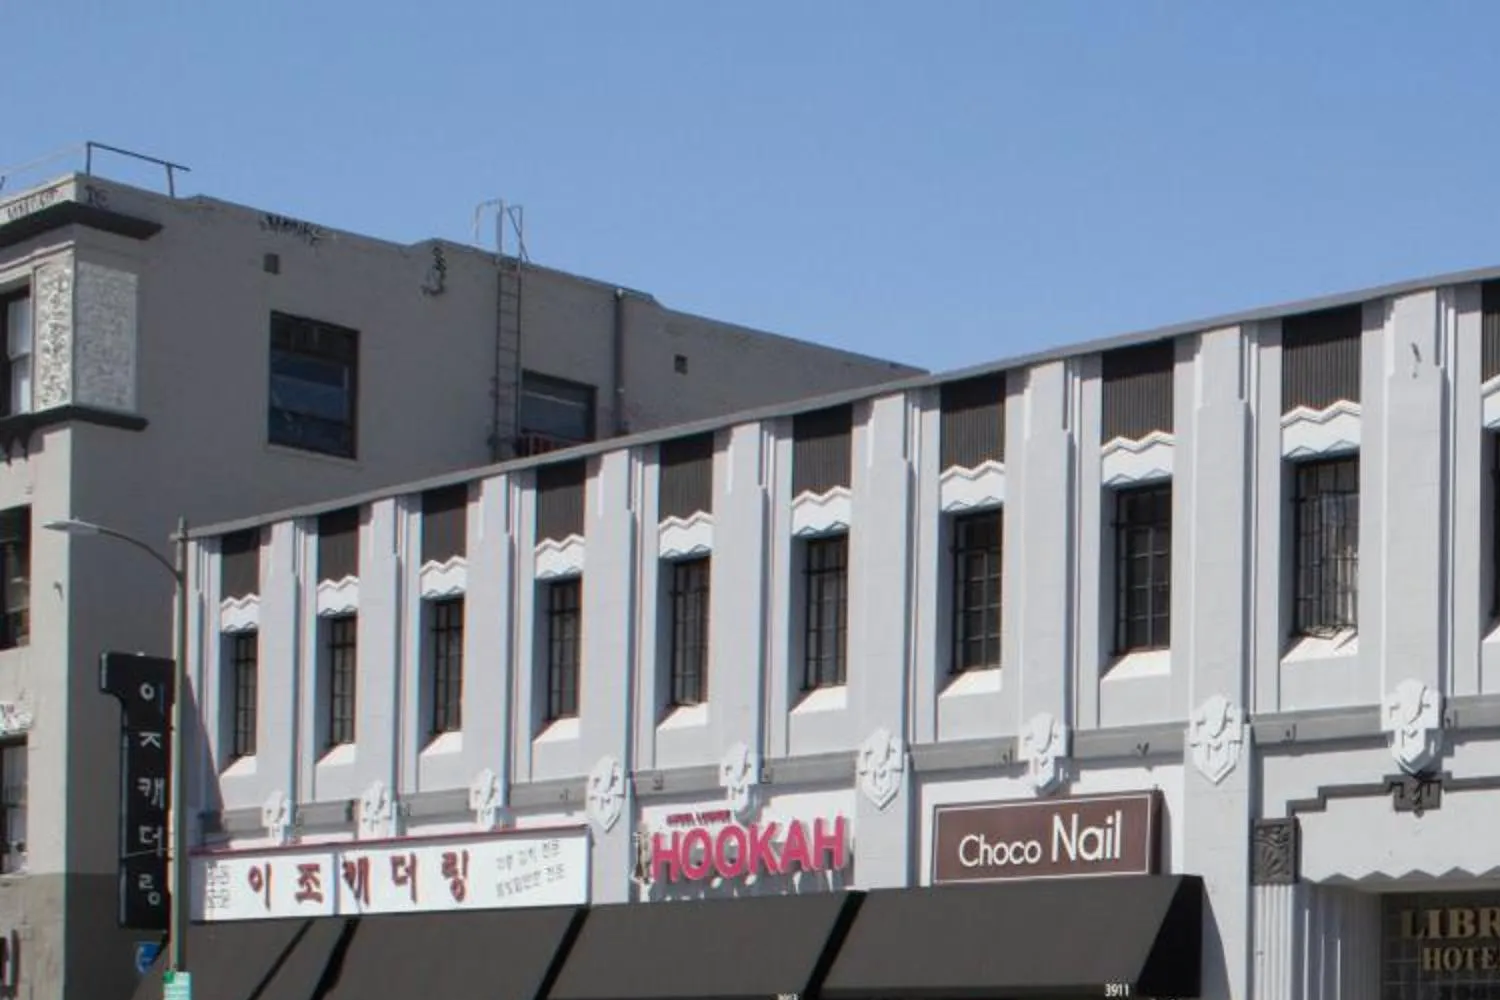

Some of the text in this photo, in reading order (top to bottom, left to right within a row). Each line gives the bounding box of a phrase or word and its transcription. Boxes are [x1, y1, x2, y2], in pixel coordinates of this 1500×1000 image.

[651, 815, 846, 882] HOOKAH
[959, 810, 1122, 867] Choco Nail
[1104, 983, 1130, 997] 3911
